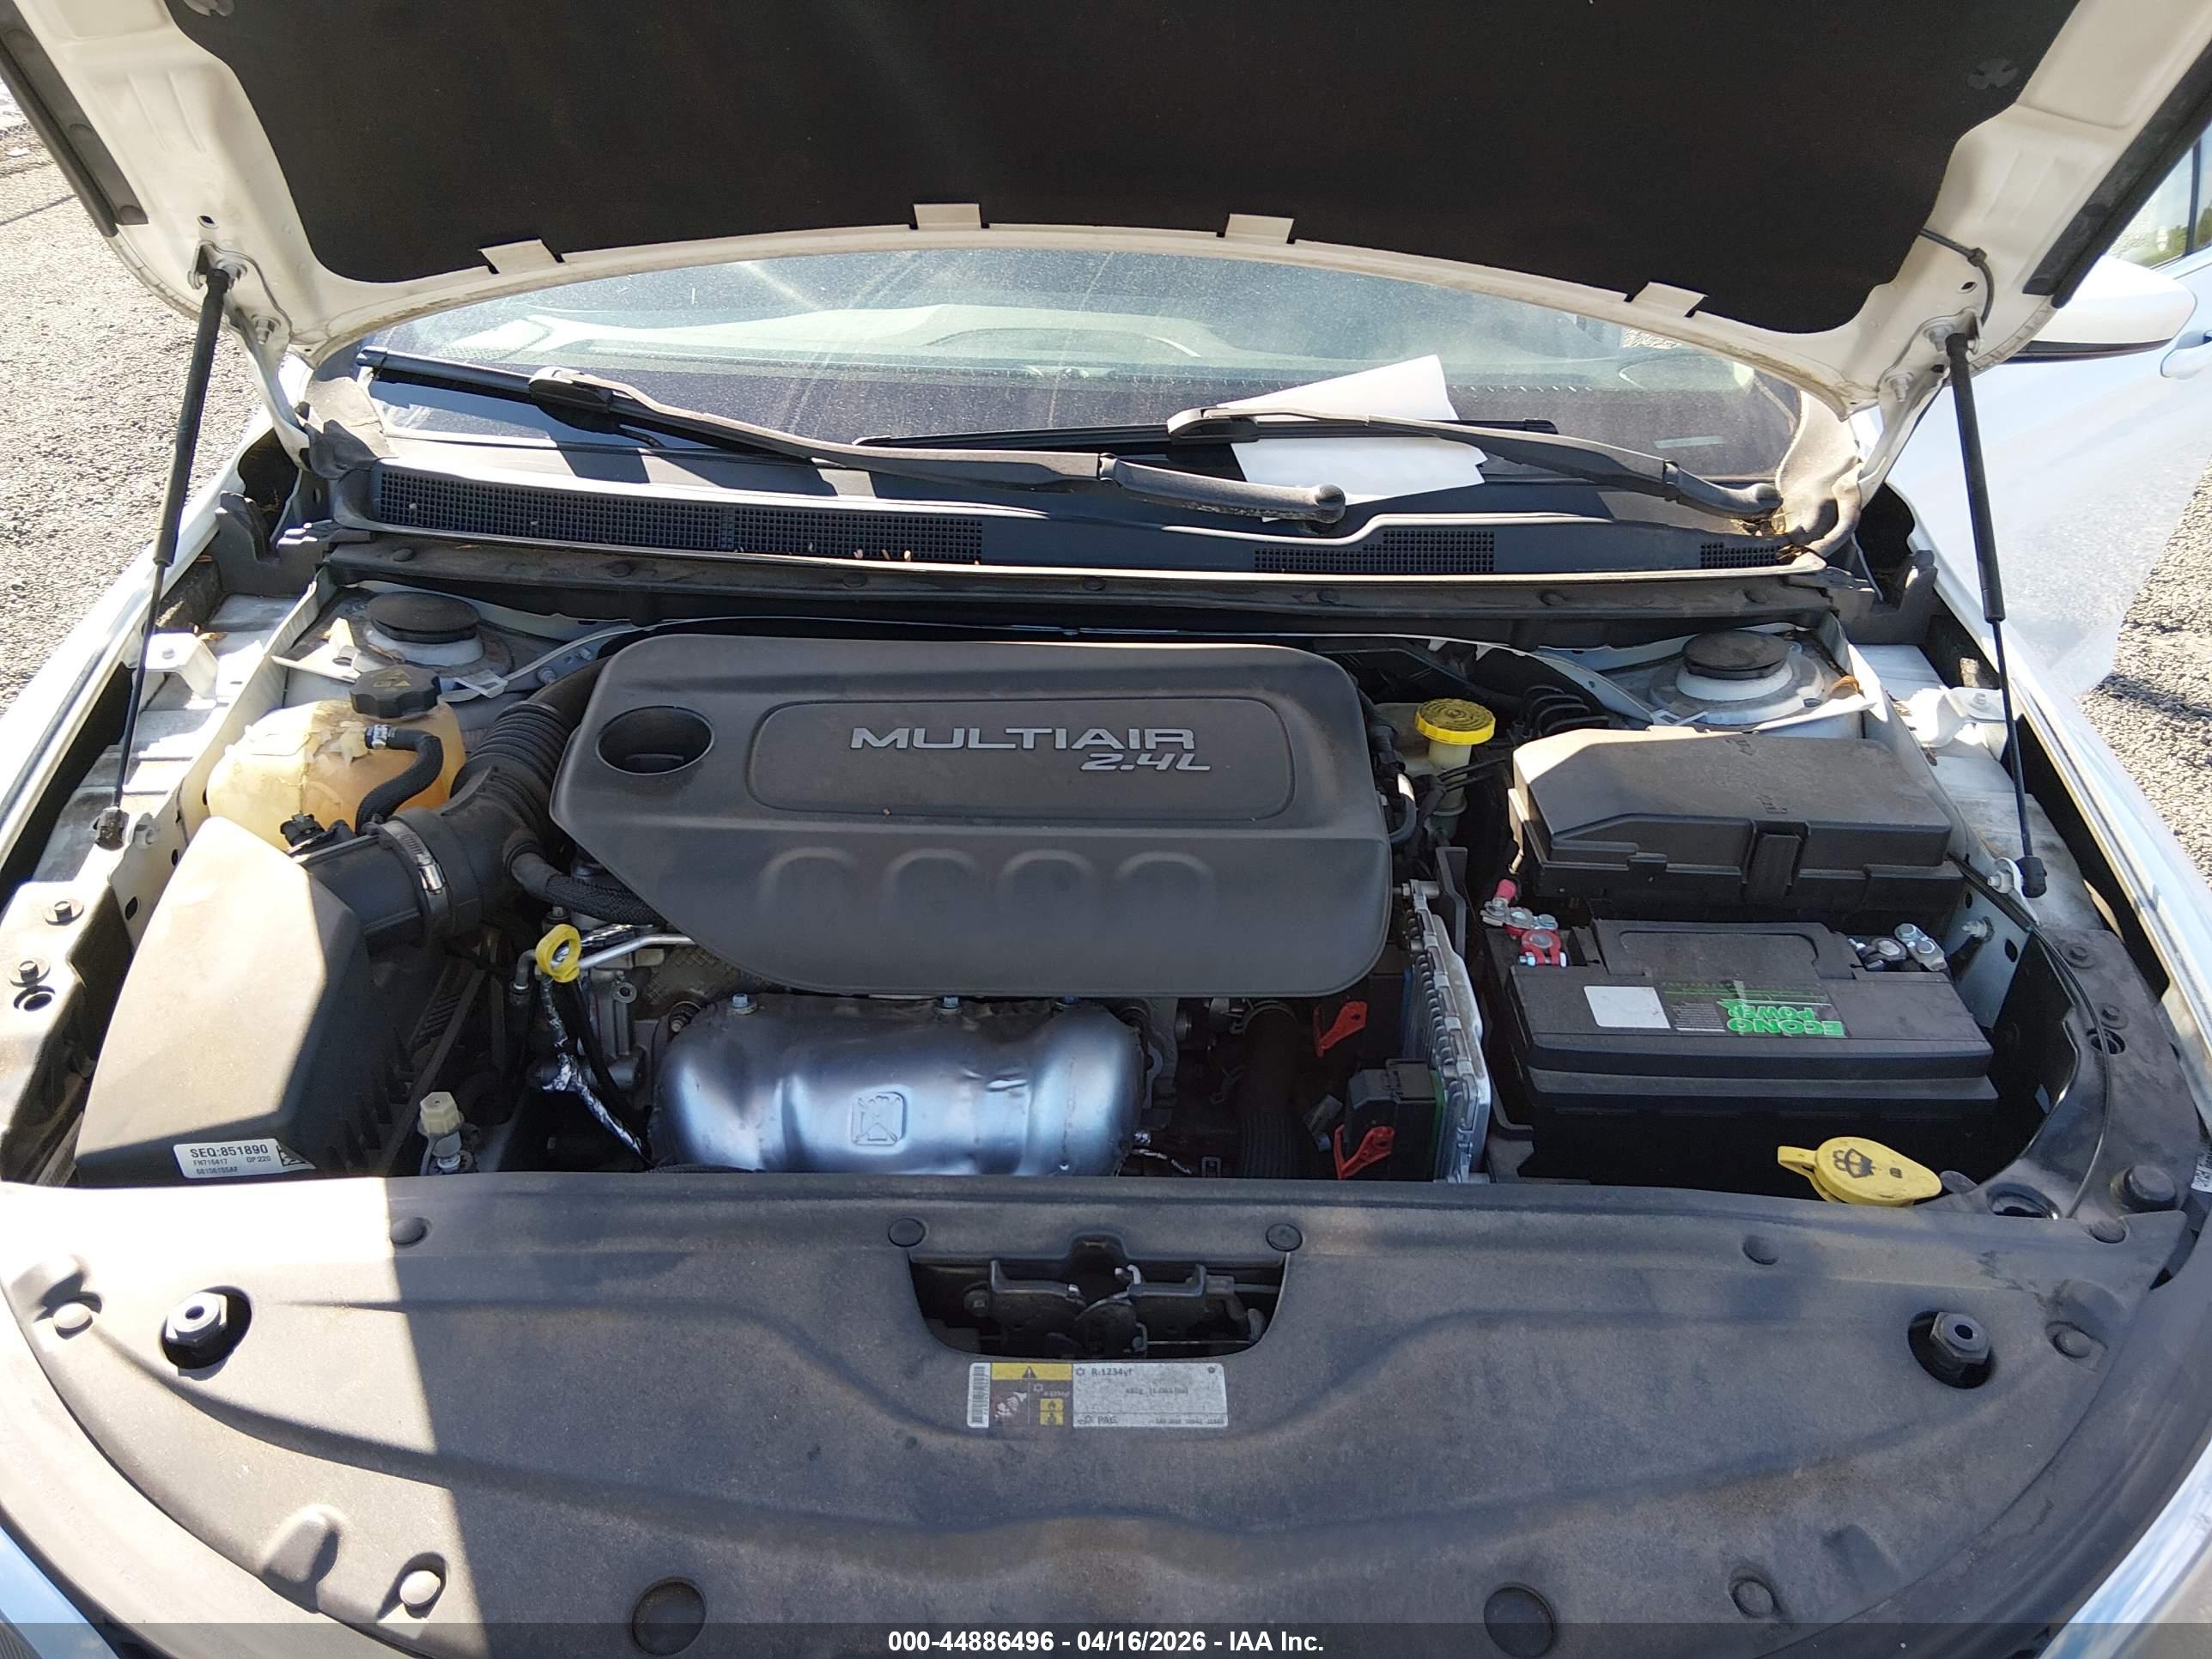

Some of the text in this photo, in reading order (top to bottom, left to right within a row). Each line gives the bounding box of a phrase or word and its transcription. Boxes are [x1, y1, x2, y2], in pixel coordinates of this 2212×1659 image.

[850, 727, 1195, 750] MULTIAIR
[1079, 752, 1212, 771] 2.4L
[1725, 1000, 1815, 1020] POWER
[1726, 1018, 1845, 1036] ECONO
[190, 1144, 269, 1158] SEQ:851890
